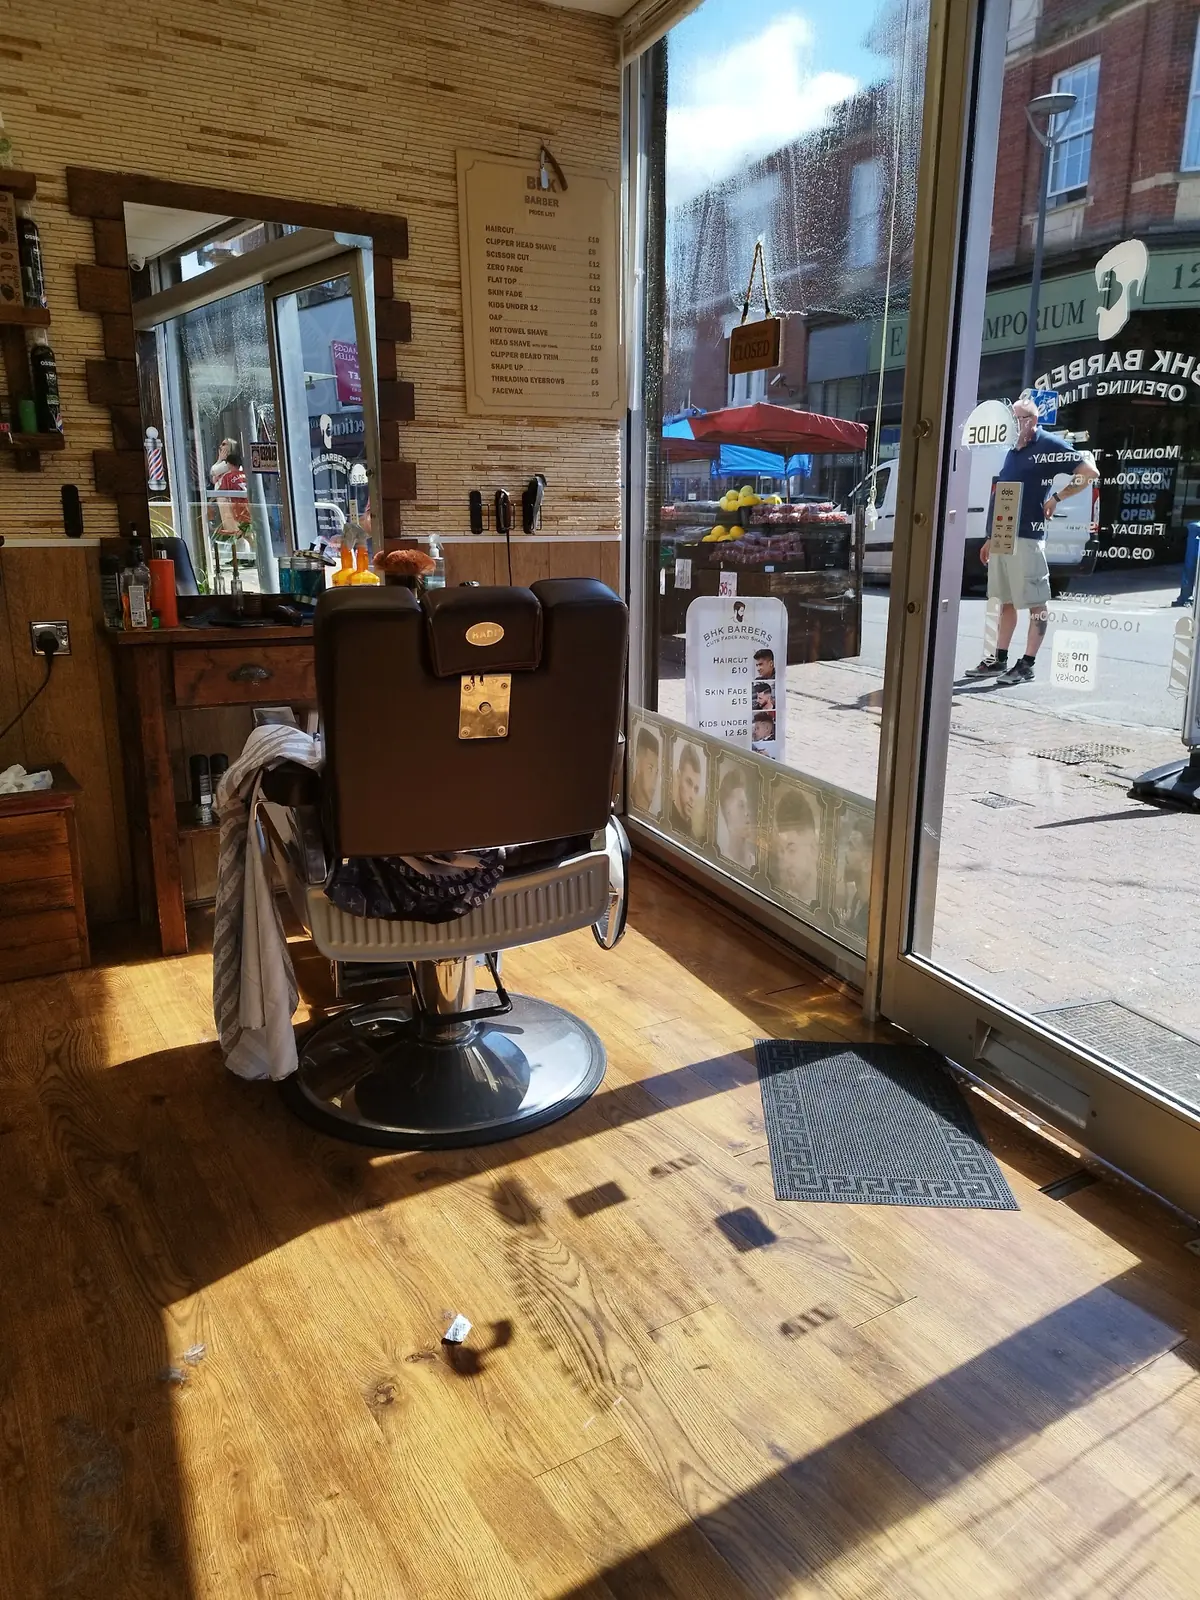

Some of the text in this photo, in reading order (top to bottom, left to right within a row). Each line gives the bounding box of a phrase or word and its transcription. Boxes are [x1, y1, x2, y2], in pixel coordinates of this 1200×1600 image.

[524, 195, 559, 208] BARBER
[485, 225, 600, 244] HAIRCUT £10
[485, 237, 515, 247] CLIPPER
[515, 240, 534, 249] HEAD
[535, 243, 557, 251] SHAVE
[486, 250, 516, 260] SCISSOR
[516, 253, 530, 261] CUT
[486, 263, 505, 271] ZERO
[506, 265, 523, 273] FADE
[487, 276, 503, 284] FLAT
[503, 277, 517, 285] TOP
[487, 288, 504, 297] SKIN
[505, 290, 523, 298] FADE
[488, 301, 505, 309] KIDS
[505, 303, 529, 311] UNDER
[489, 326, 503, 334] HOT
[503, 327, 526, 335] TOWEL
[490, 338, 508, 346] HEAD
[490, 351, 518, 359] CLIPPER
[733, 340, 770, 361] CLOSED
[491, 375, 529, 383] THREADING
[530, 377, 565, 385] EYEBROWS
[492, 387, 523, 395] FACEWAX
[321, 453, 351, 469] BARBERS
[353, 474, 365, 483] SLIDE
[1122, 493, 1157, 505] SHOP
[1121, 509, 1156, 521] OPEN
[703, 625, 773, 642] BHK BARBERS
[751, 636, 770, 648] SHADES
[713, 656, 748, 664] HAIRCUT
[731, 666, 748, 674] £10
[705, 688, 725, 696] SKIN
[698, 719, 748, 728] KIDS UNDER
[725, 728, 748, 737] 12 £8
